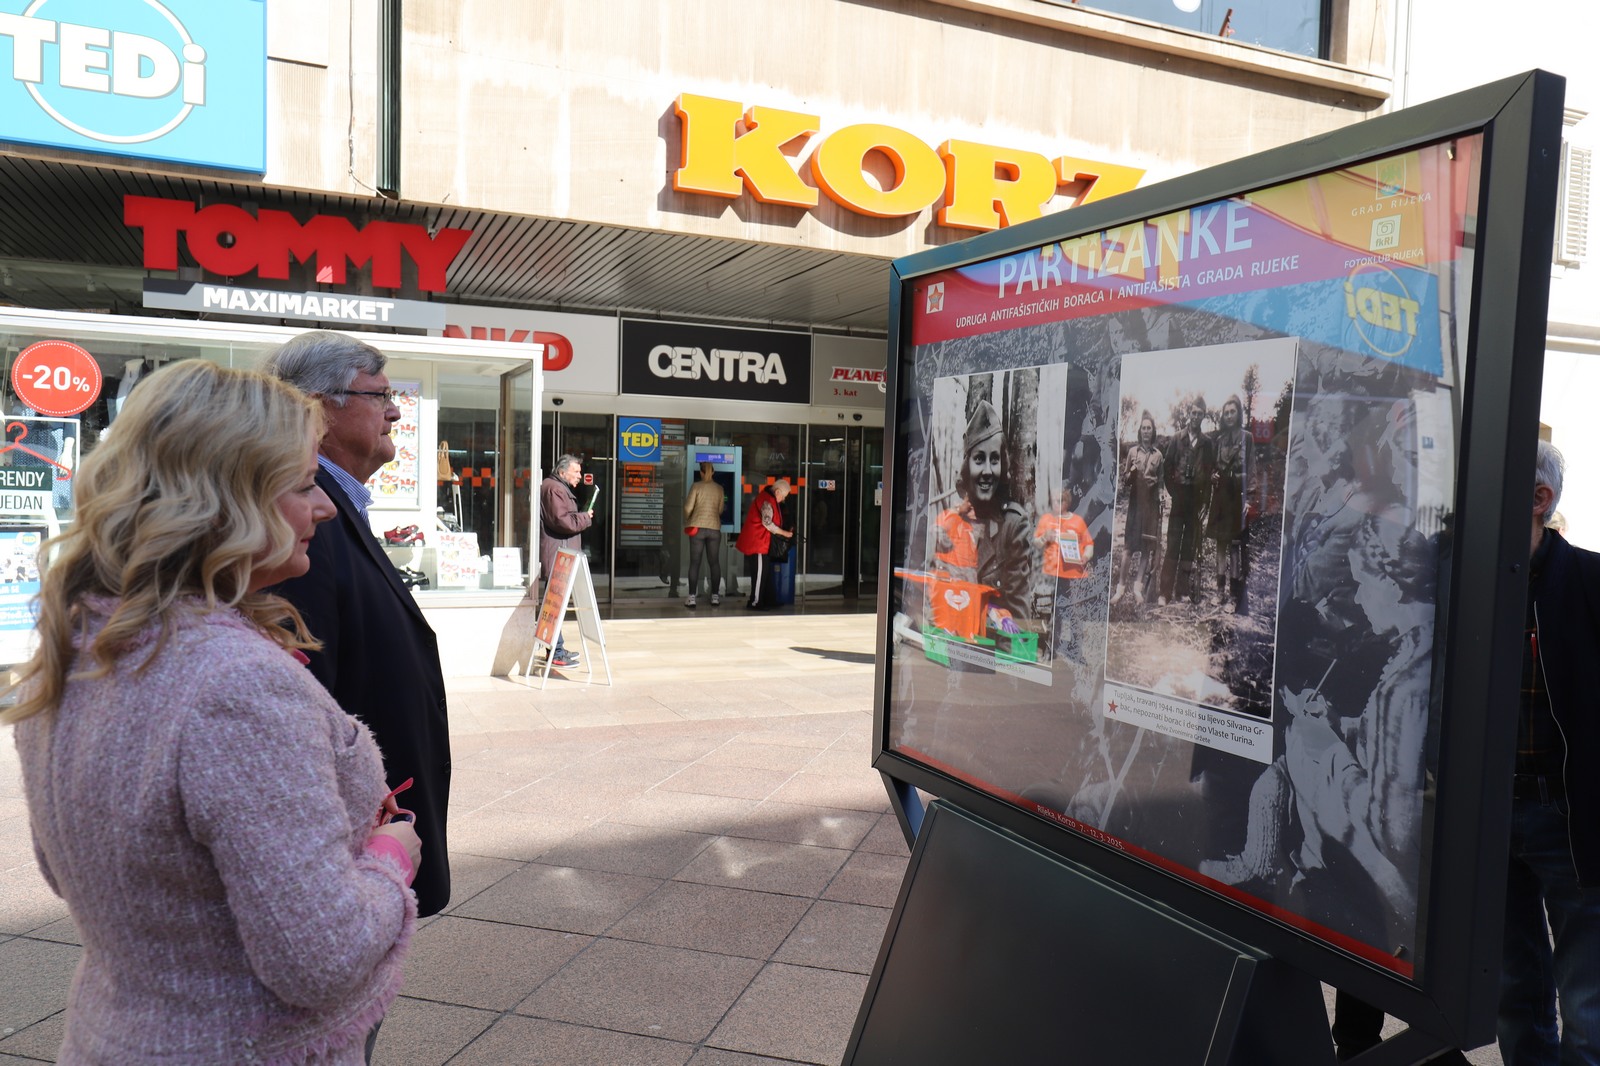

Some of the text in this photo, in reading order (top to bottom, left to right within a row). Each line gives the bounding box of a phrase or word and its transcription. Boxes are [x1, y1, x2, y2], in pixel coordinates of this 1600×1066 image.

[0, 11, 206, 106] TEDi
[1351, 192, 1432, 217] GRAD RIJEKA
[123, 194, 474, 292] TOMMY
[1344, 247, 1424, 269] FOTOKLUB RIJEKA
[203, 286, 395, 322] MAXIMARKET
[955, 255, 1300, 329] UDRUGA ANTIFAŠISTIČKIH BORACA I ANTIFAŠISTA GRADA RIJEKE
[22, 364, 91, 392] -20%
[648, 344, 787, 385] CENTRA
[843, 388, 858, 397] kat
[620, 431, 659, 448] TEDi
[1120, 703, 1132, 714] bac,
[1133, 707, 1163, 721] nepoznati
[1164, 714, 1181, 726] borac
[1186, 721, 1207, 734] desno
[1207, 726, 1229, 739] Vlaste
[1231, 732, 1255, 747] Turina.
[1136, 696, 1157, 709] travanj
[1159, 702, 1175, 713] 1944.
[1175, 707, 1183, 715] na
[1185, 707, 1197, 718] slici
[1198, 713, 1206, 721] su
[1207, 714, 1225, 726] lijevo
[1227, 719, 1252, 733] Silvana
[1253, 726, 1265, 736] Gr-
[1057, 814, 1076, 828] Korzo
[1107, 836, 1125, 850] 2025.
